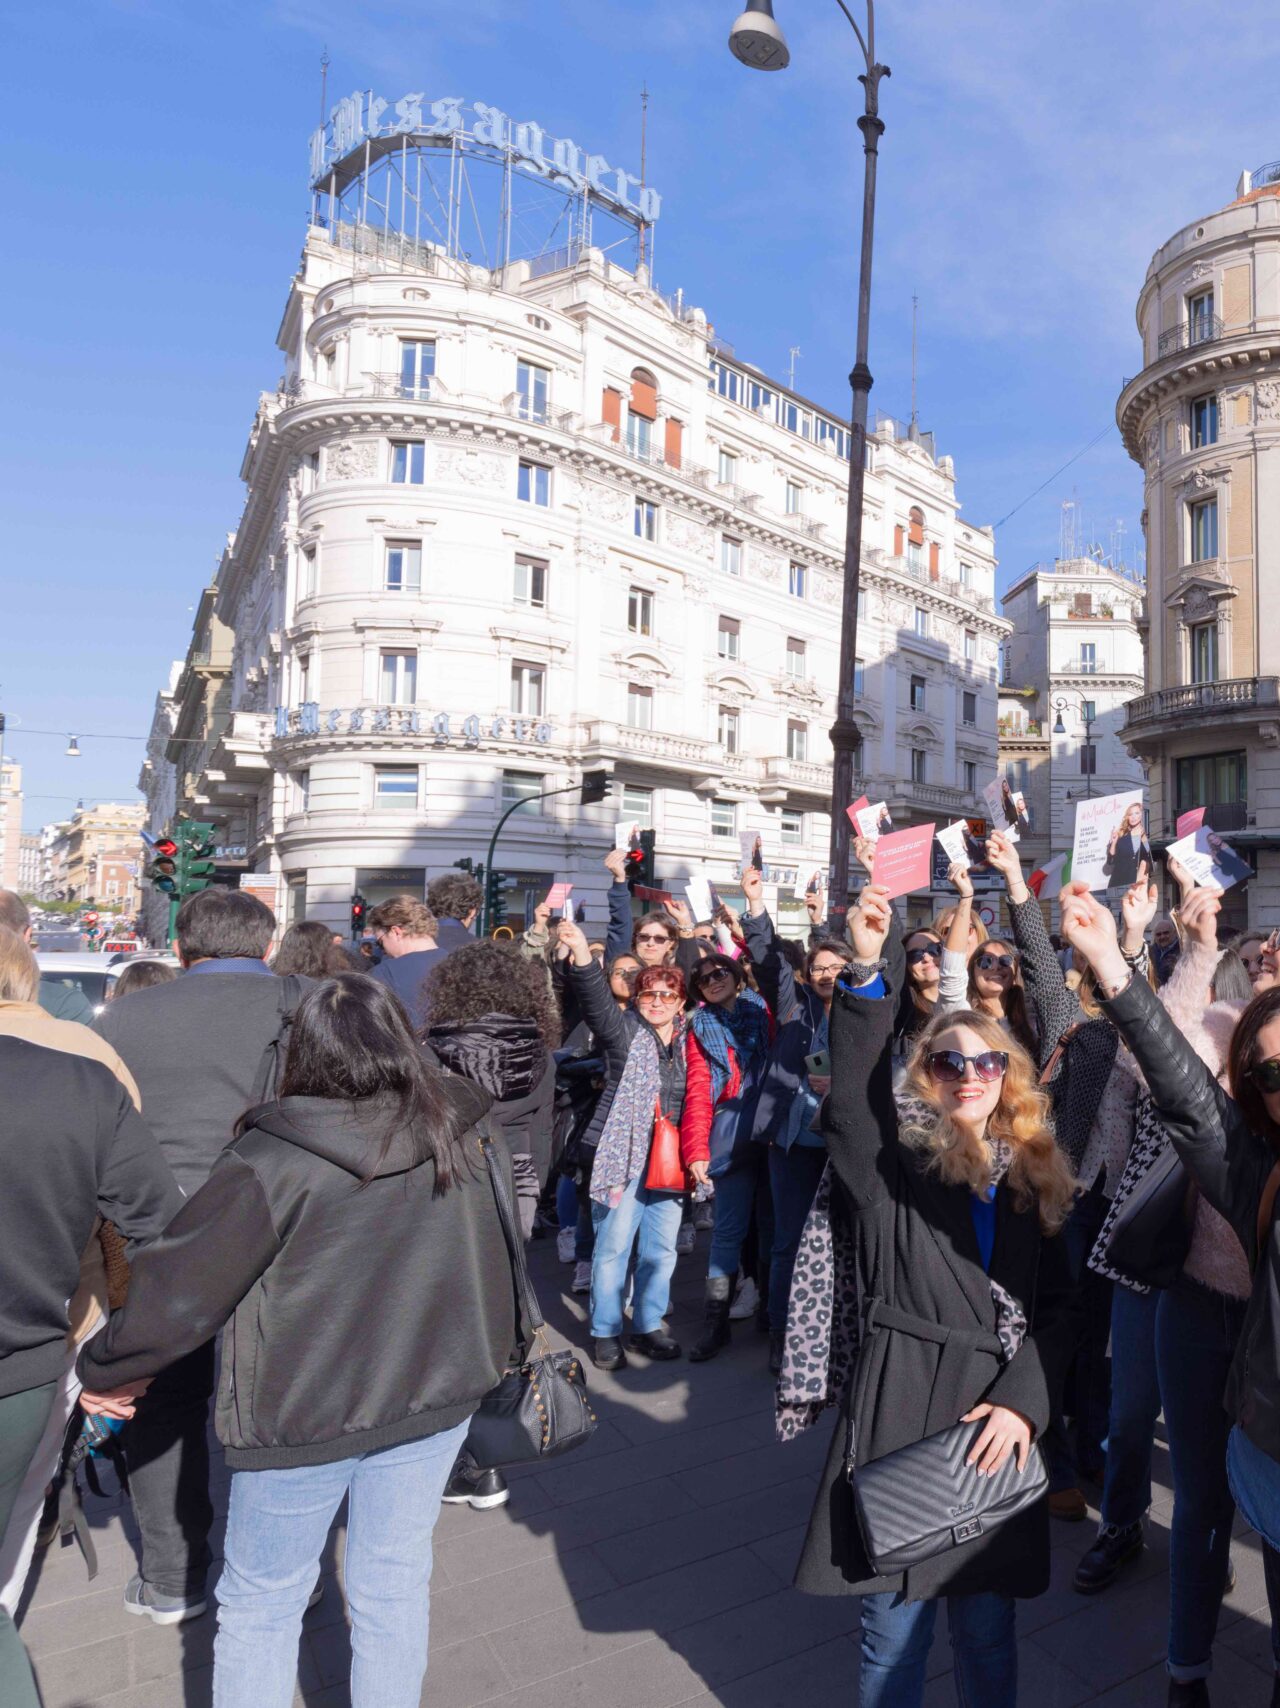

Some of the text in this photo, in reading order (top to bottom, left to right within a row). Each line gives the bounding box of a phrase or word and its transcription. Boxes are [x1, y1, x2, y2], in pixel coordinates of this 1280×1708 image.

[329, 90, 663, 223] Messaggero
[299, 702, 557, 747] Messaggero
[106, 943, 136, 952] TAXI
